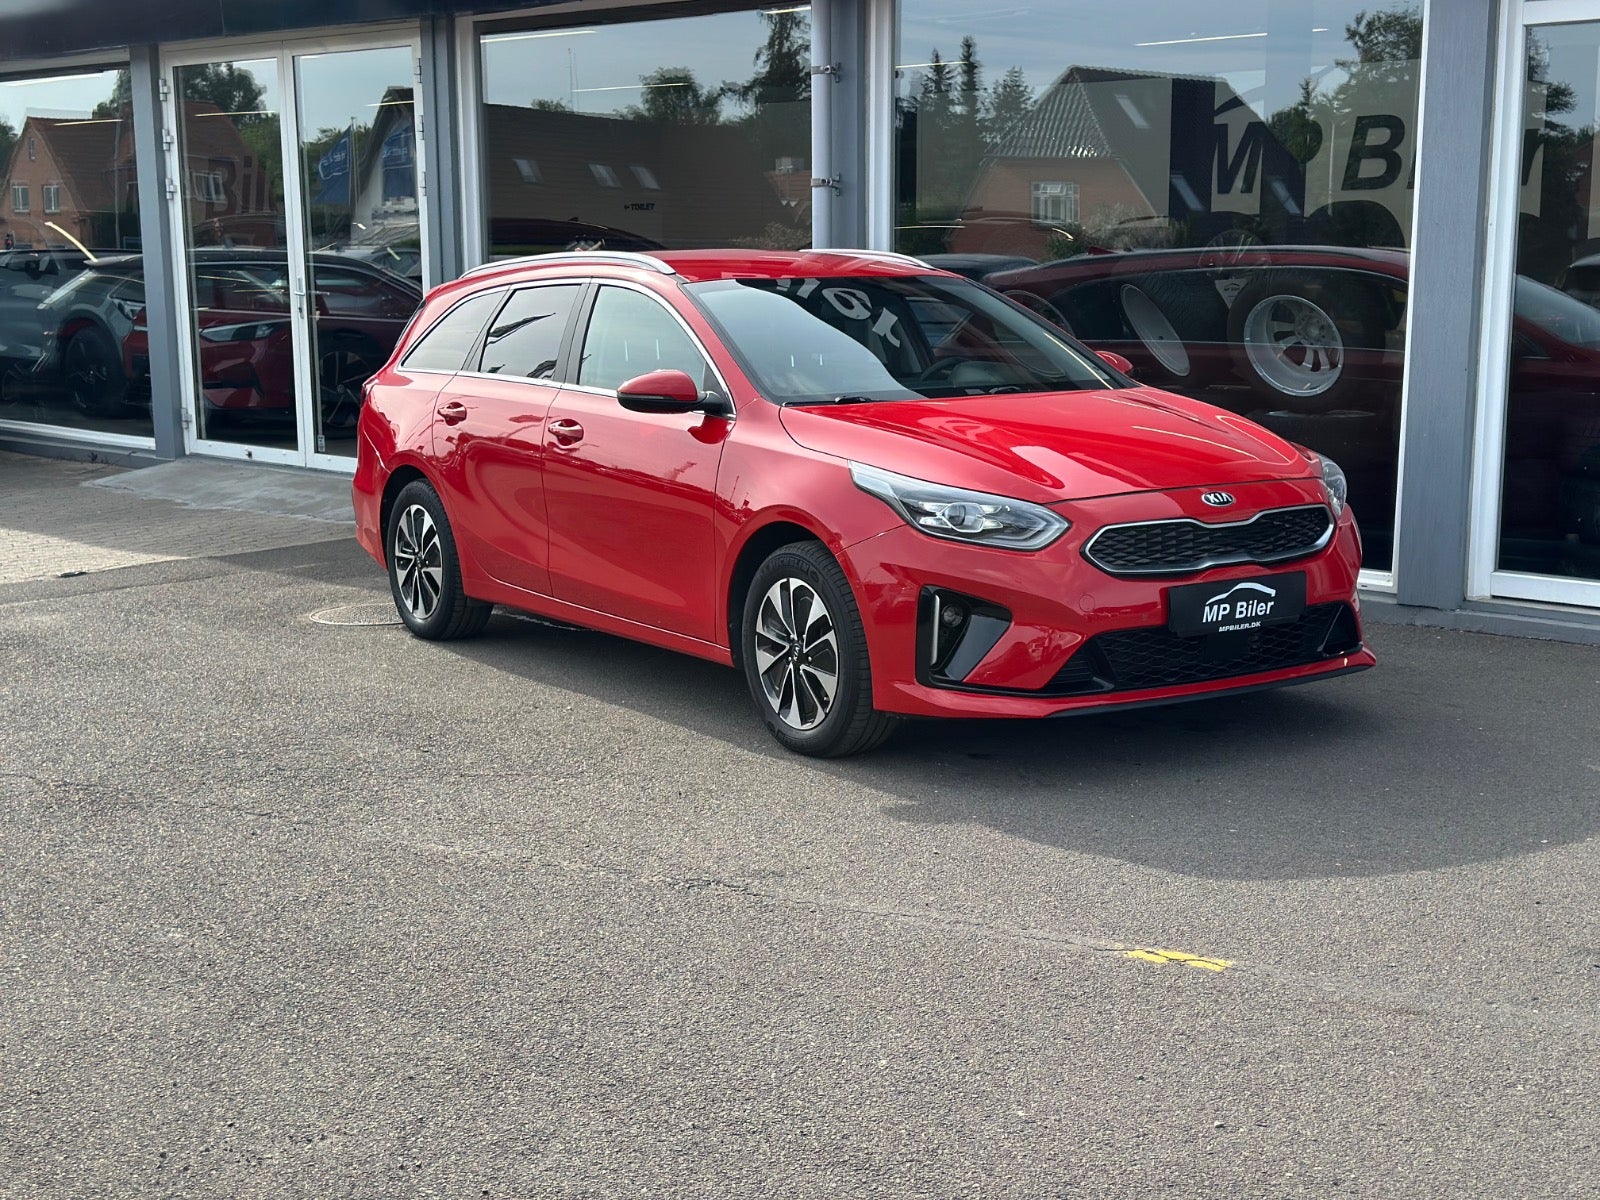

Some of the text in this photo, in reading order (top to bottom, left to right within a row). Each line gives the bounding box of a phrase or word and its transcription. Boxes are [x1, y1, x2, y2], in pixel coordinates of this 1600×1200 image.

[630, 203, 655, 211] TOILET
[1206, 492, 1232, 504] KIA
[1203, 599, 1275, 623] MP Biler
[1218, 620, 1262, 632] MPBILER.DK
